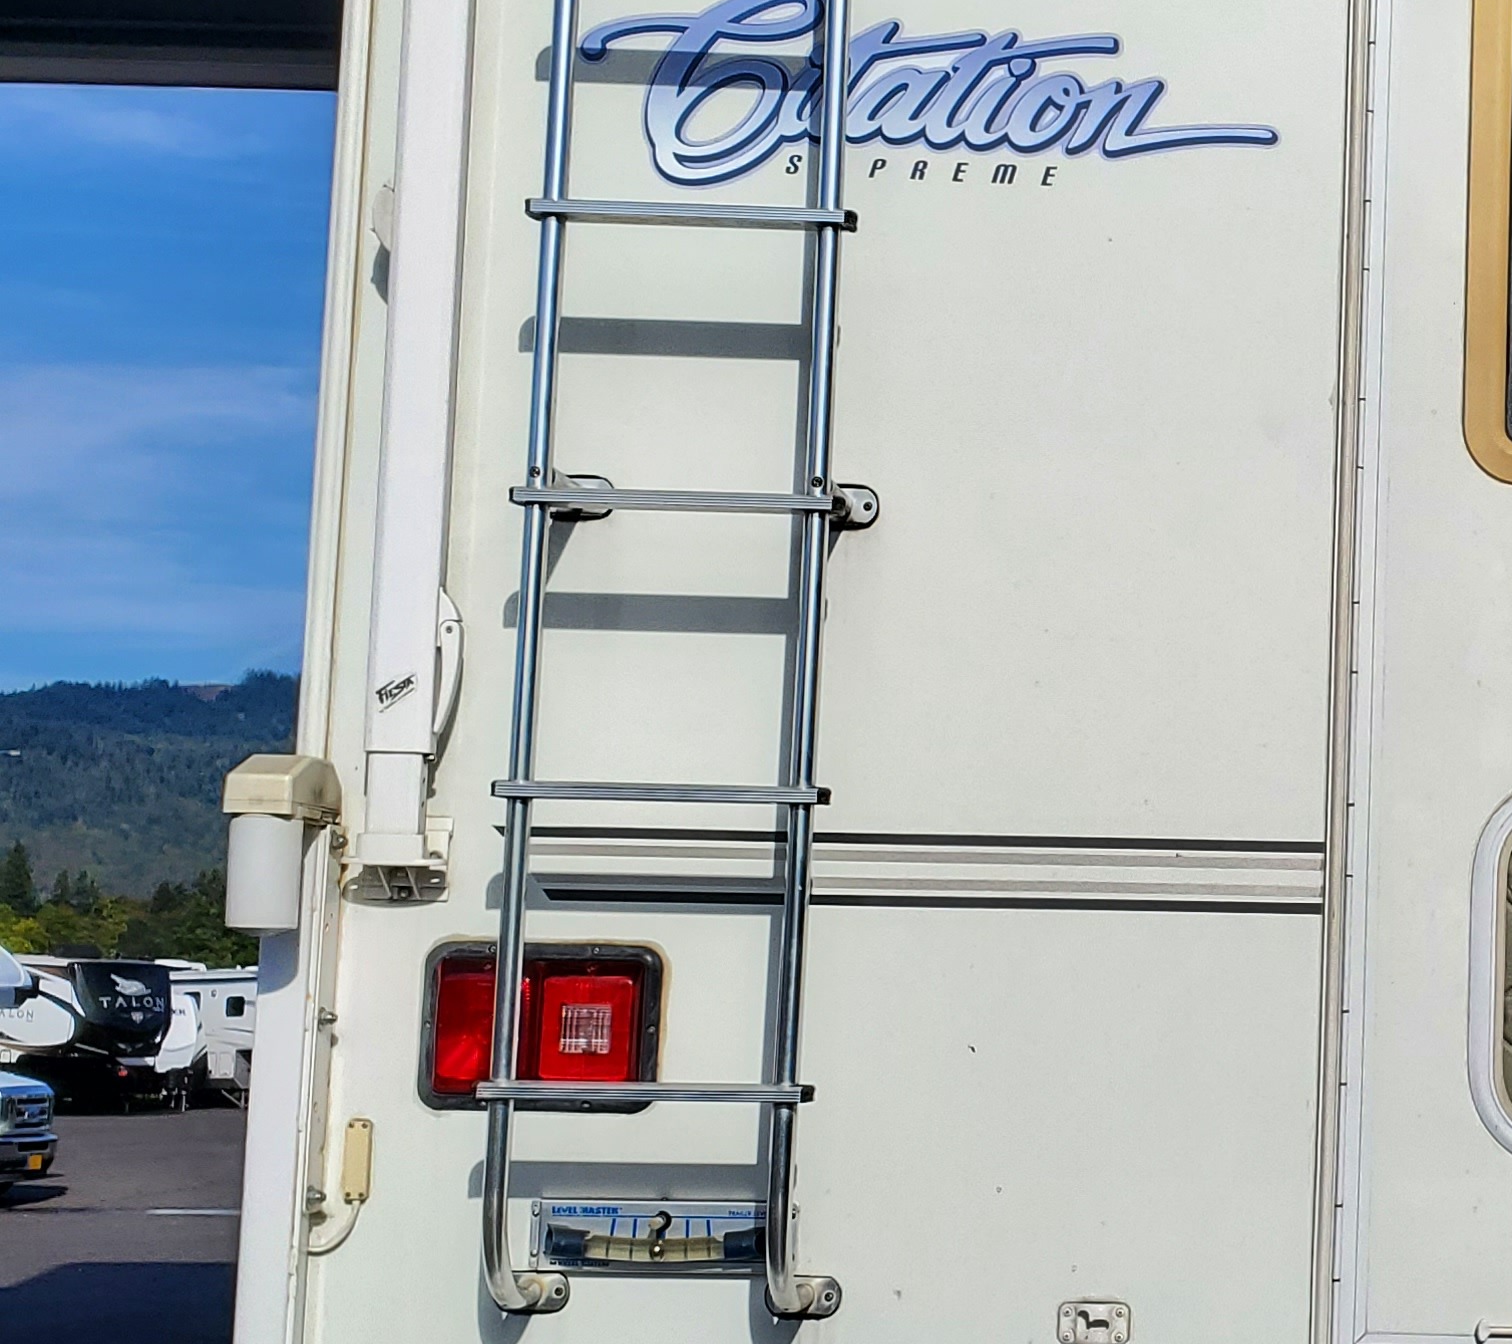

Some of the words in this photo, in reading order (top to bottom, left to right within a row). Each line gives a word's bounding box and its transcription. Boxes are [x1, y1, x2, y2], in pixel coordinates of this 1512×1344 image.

[785, 155, 1059, 187] SPREME
[99, 996, 164, 1009] TALON
[552, 1206, 578, 1214] LEVEL
